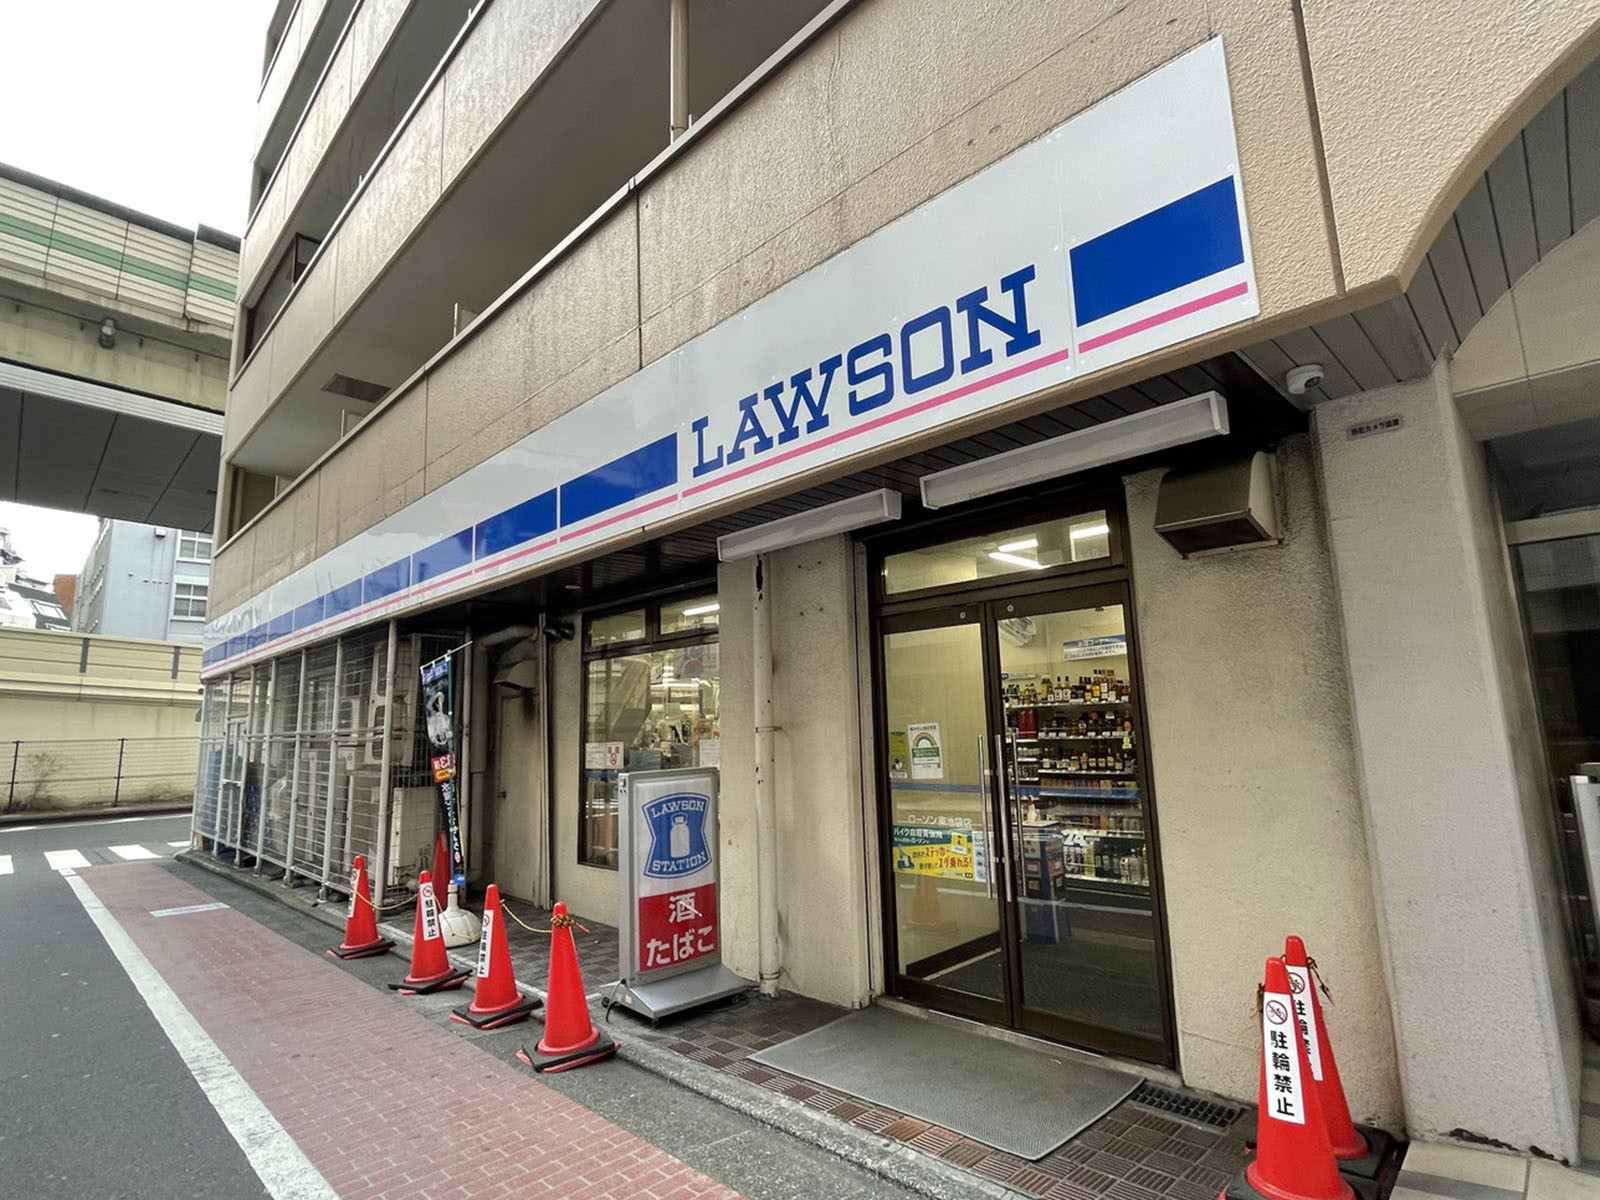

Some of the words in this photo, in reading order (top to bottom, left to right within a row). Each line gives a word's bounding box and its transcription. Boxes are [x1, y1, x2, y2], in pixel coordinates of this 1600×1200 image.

[692, 264, 1041, 478] LAWSON
[651, 799, 705, 818] LAWSON
[652, 852, 706, 872] STATION
[669, 892, 696, 924] 酒
[646, 925, 714, 967] たばこ
[1270, 1030, 1295, 1117] 駐輪禁止
